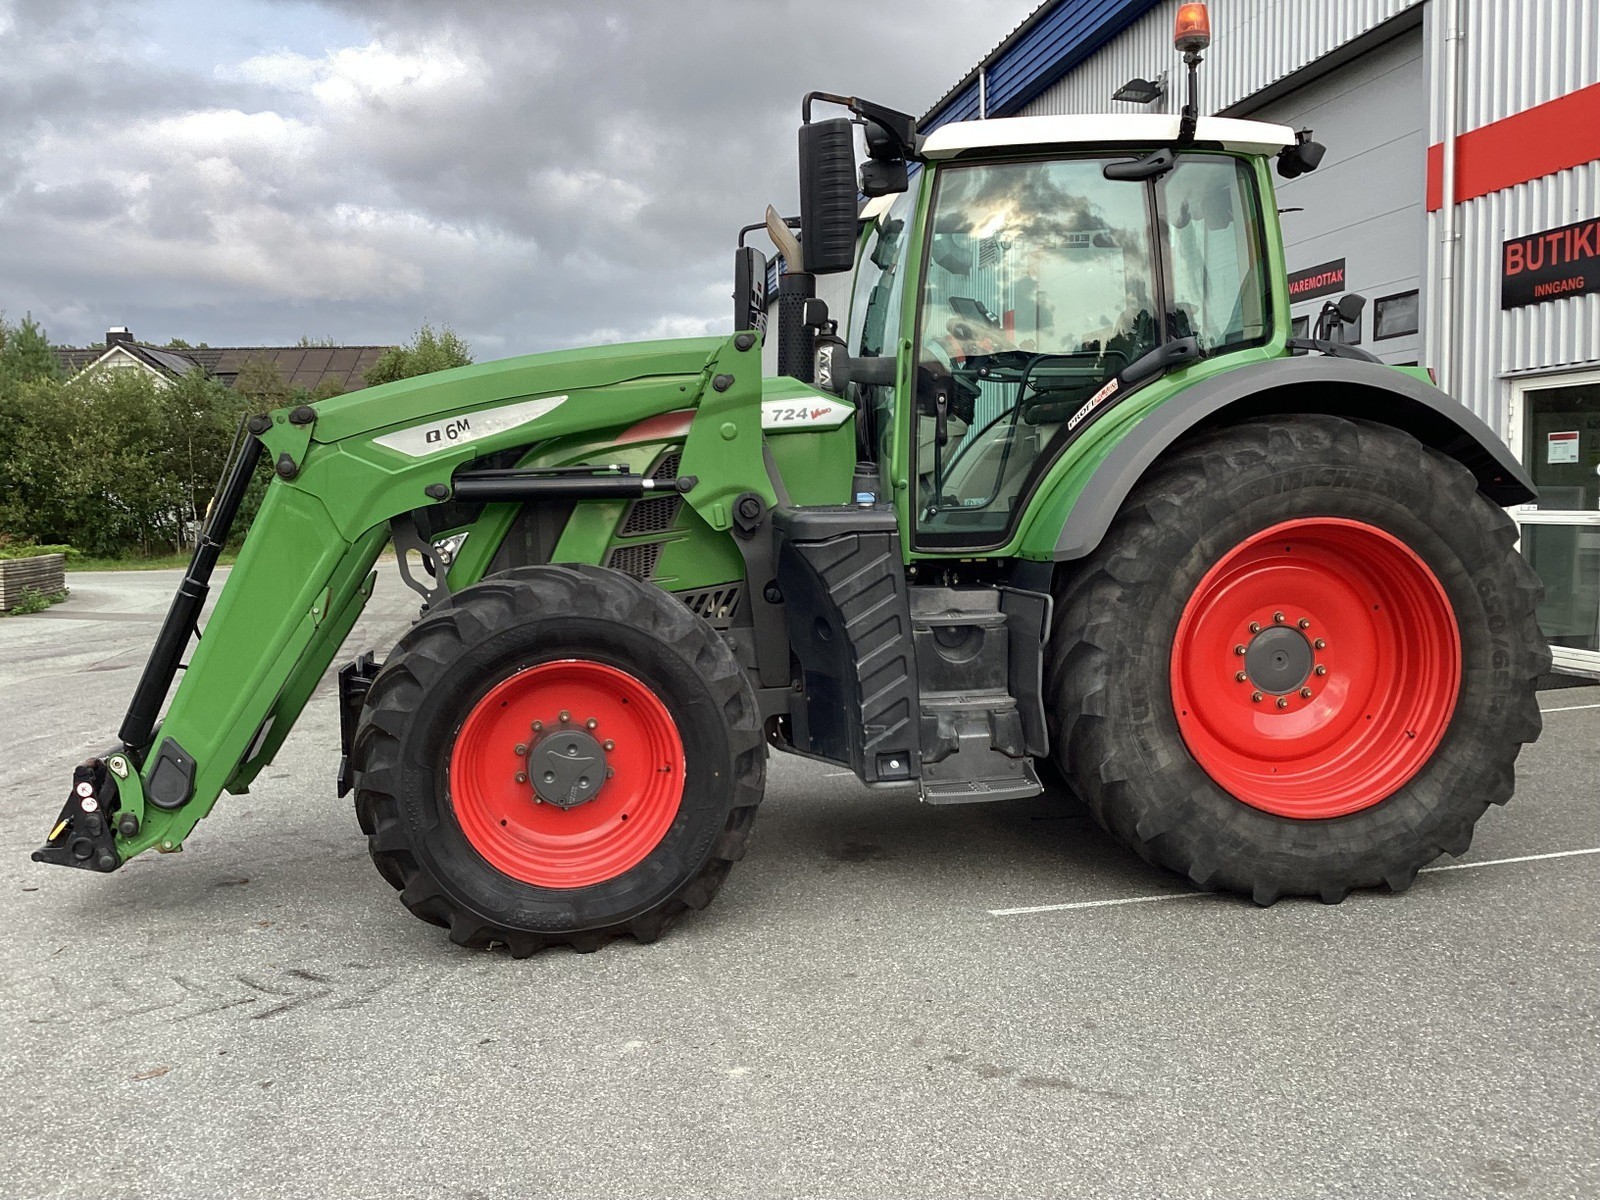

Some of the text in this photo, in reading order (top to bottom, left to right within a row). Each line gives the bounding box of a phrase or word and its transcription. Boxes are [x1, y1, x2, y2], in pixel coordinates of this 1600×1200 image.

[1506, 222, 1600, 276] BUTIK
[1288, 269, 1343, 294] VAREMOTTAK
[1535, 276, 1584, 297] INNGANG
[772, 407, 808, 422] 724
